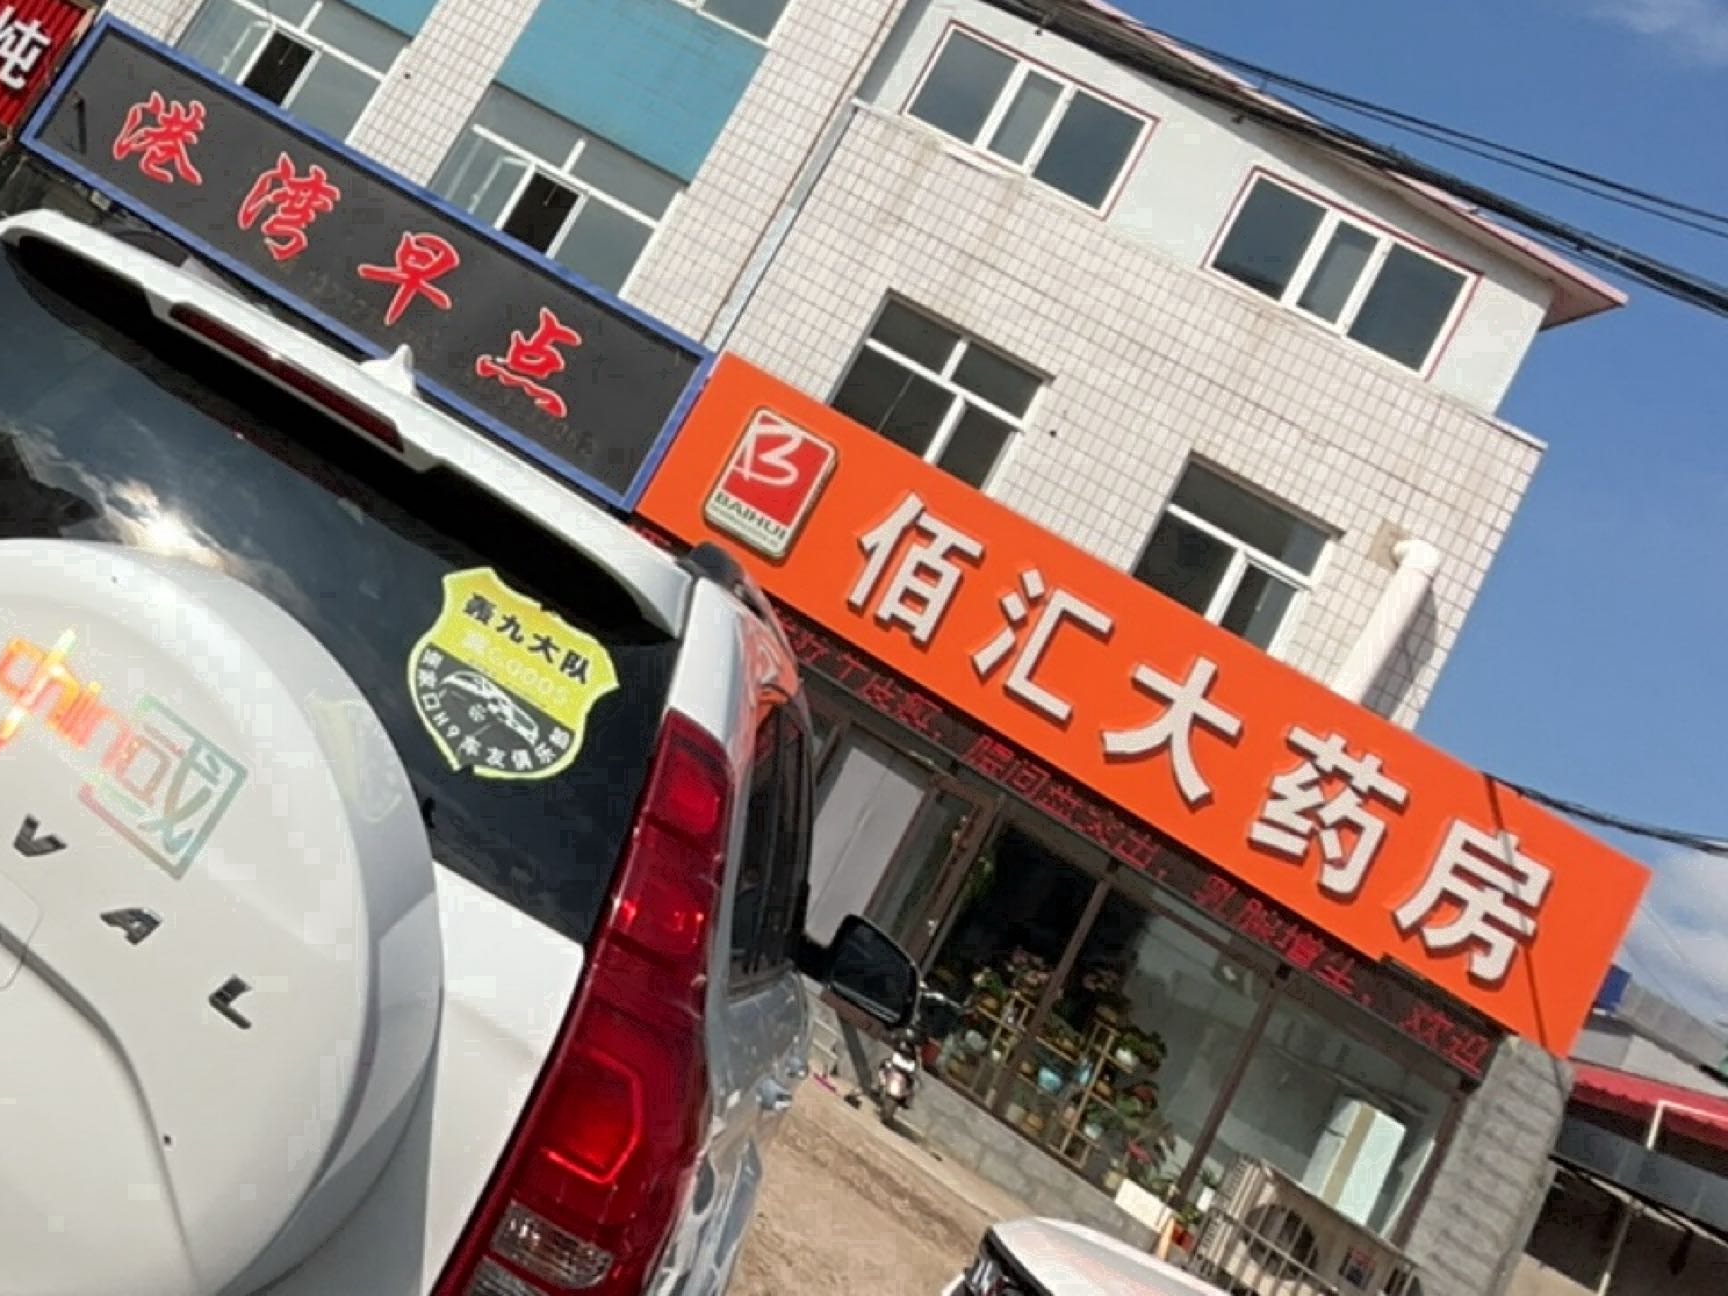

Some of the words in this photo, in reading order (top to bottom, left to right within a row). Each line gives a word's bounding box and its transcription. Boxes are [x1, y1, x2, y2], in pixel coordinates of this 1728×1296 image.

[113, 90, 583, 419] 港湾早点
[714, 491, 787, 541] BAIHUI
[846, 490, 1555, 985] 佰汇大药房
